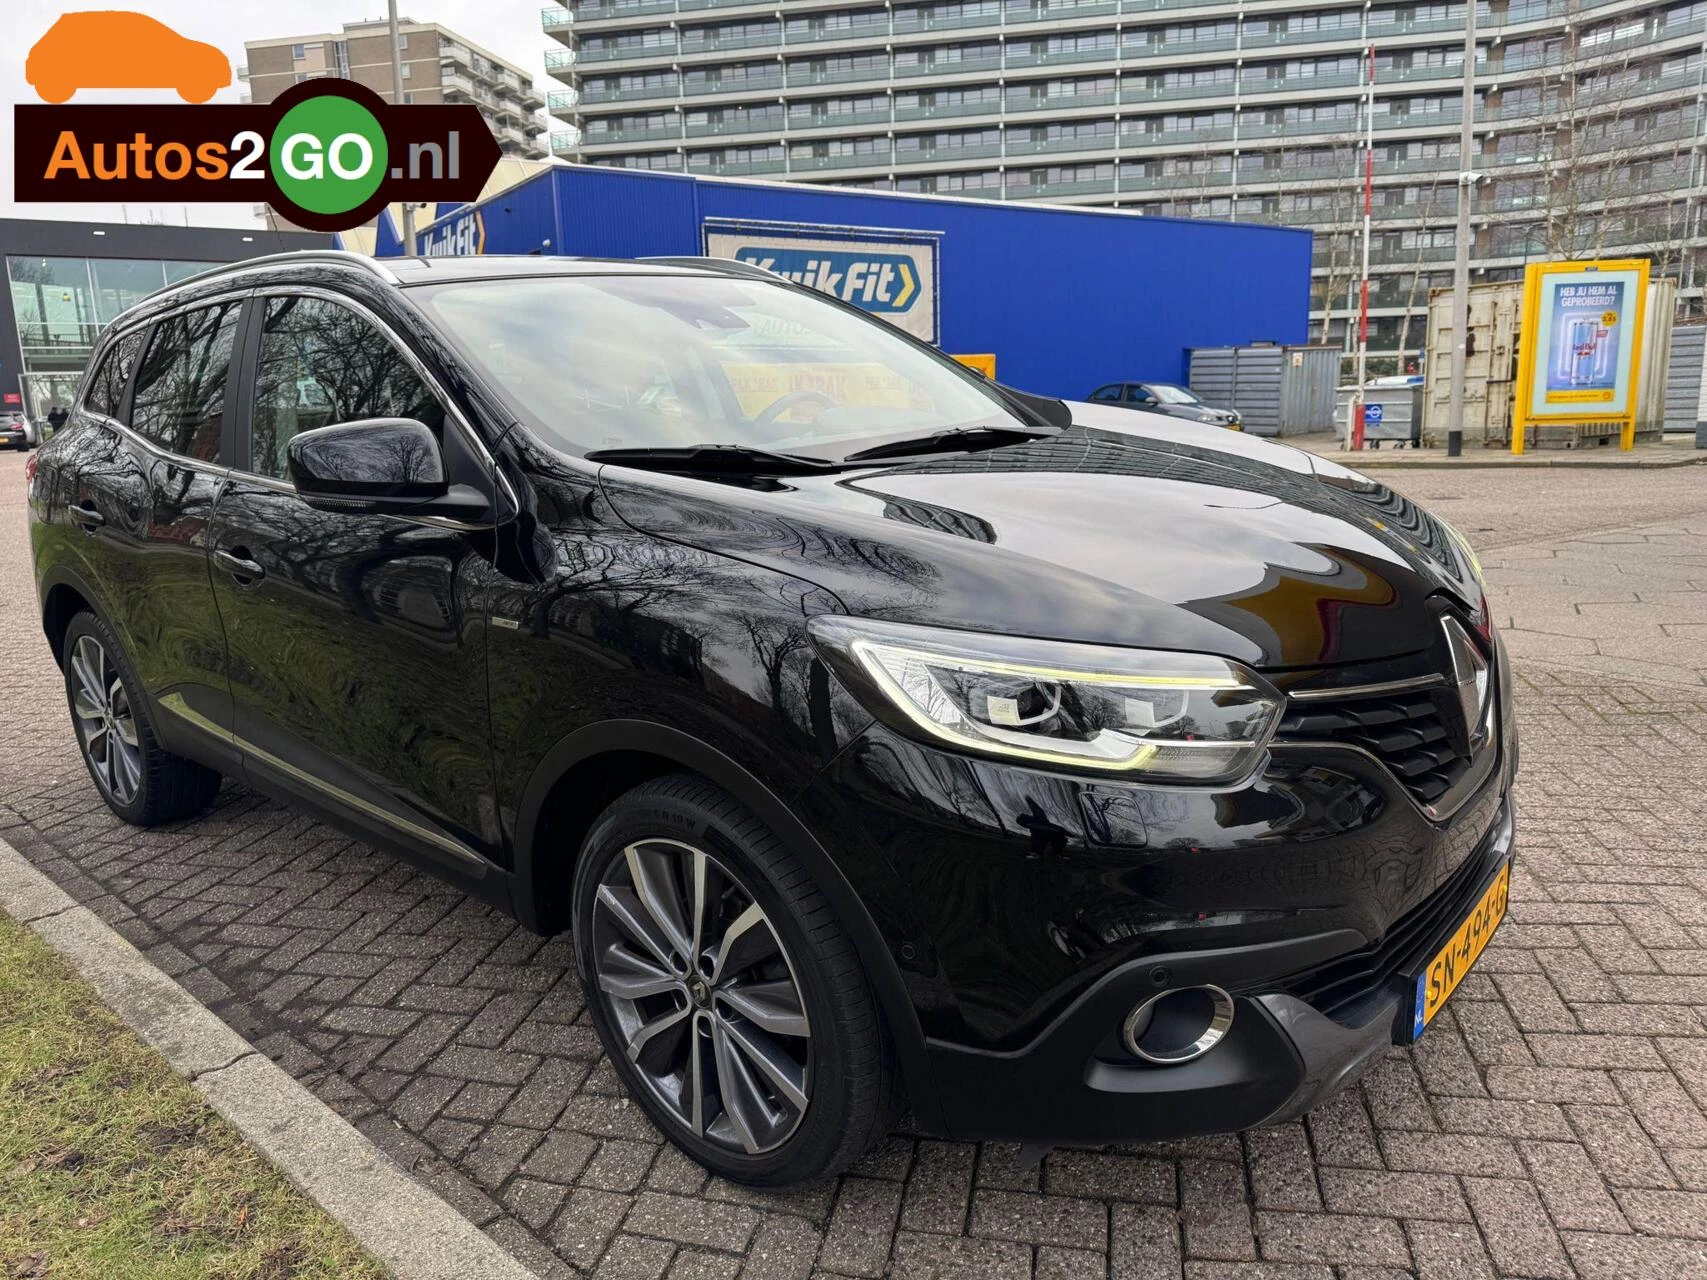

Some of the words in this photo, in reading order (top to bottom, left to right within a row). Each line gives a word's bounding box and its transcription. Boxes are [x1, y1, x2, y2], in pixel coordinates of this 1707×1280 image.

[1560, 287, 1575, 297] HEB
[1588, 285, 1606, 295] HEM
[1607, 285, 1617, 295] AL
[1561, 296, 1615, 307] GEPROBEERD?
[1430, 874, 1507, 1008] SN-494-G
